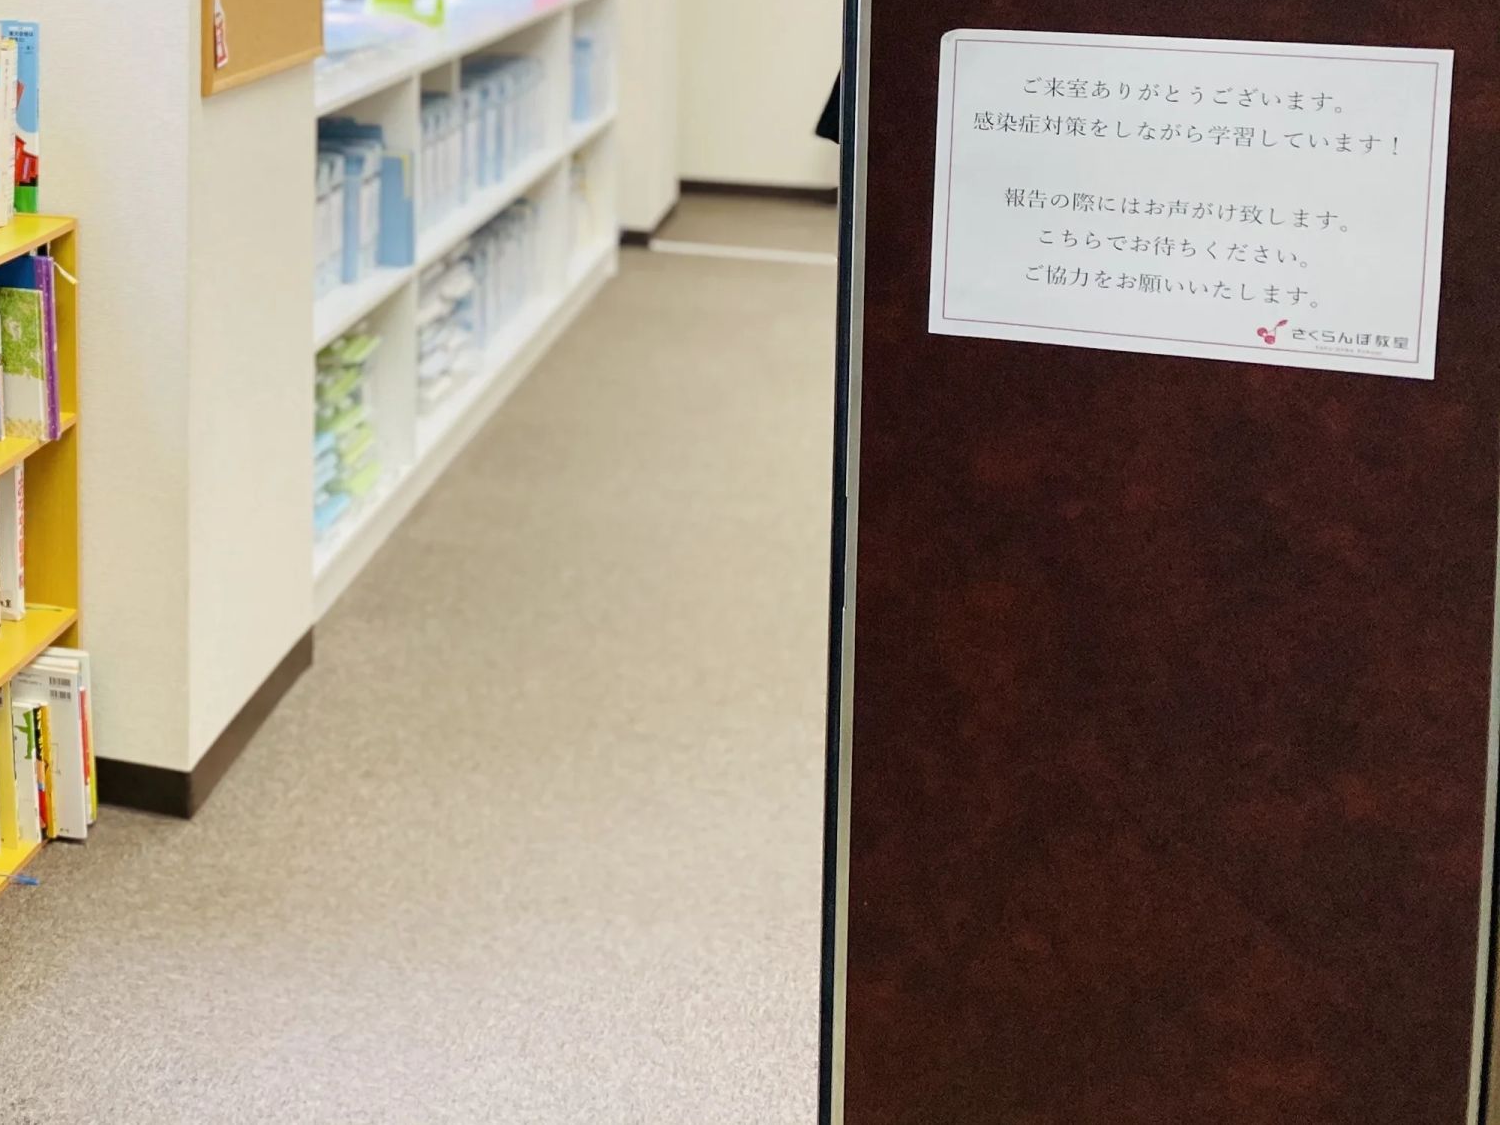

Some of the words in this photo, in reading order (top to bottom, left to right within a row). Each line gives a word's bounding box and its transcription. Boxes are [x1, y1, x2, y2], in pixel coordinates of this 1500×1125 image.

[1023, 77, 1347, 115] ご来室ありがとうございます。
[973, 111, 1400, 156] 感染症対策をしながら学習しています！
[1004, 186, 1351, 234] 報告の際にはお声がけ致します。
[1038, 228, 1310, 270] こちらでお待ちください。
[1025, 265, 1323, 310] ご協力をお願いいたします。
[1292, 328, 1409, 350] さくらんぼ教室
